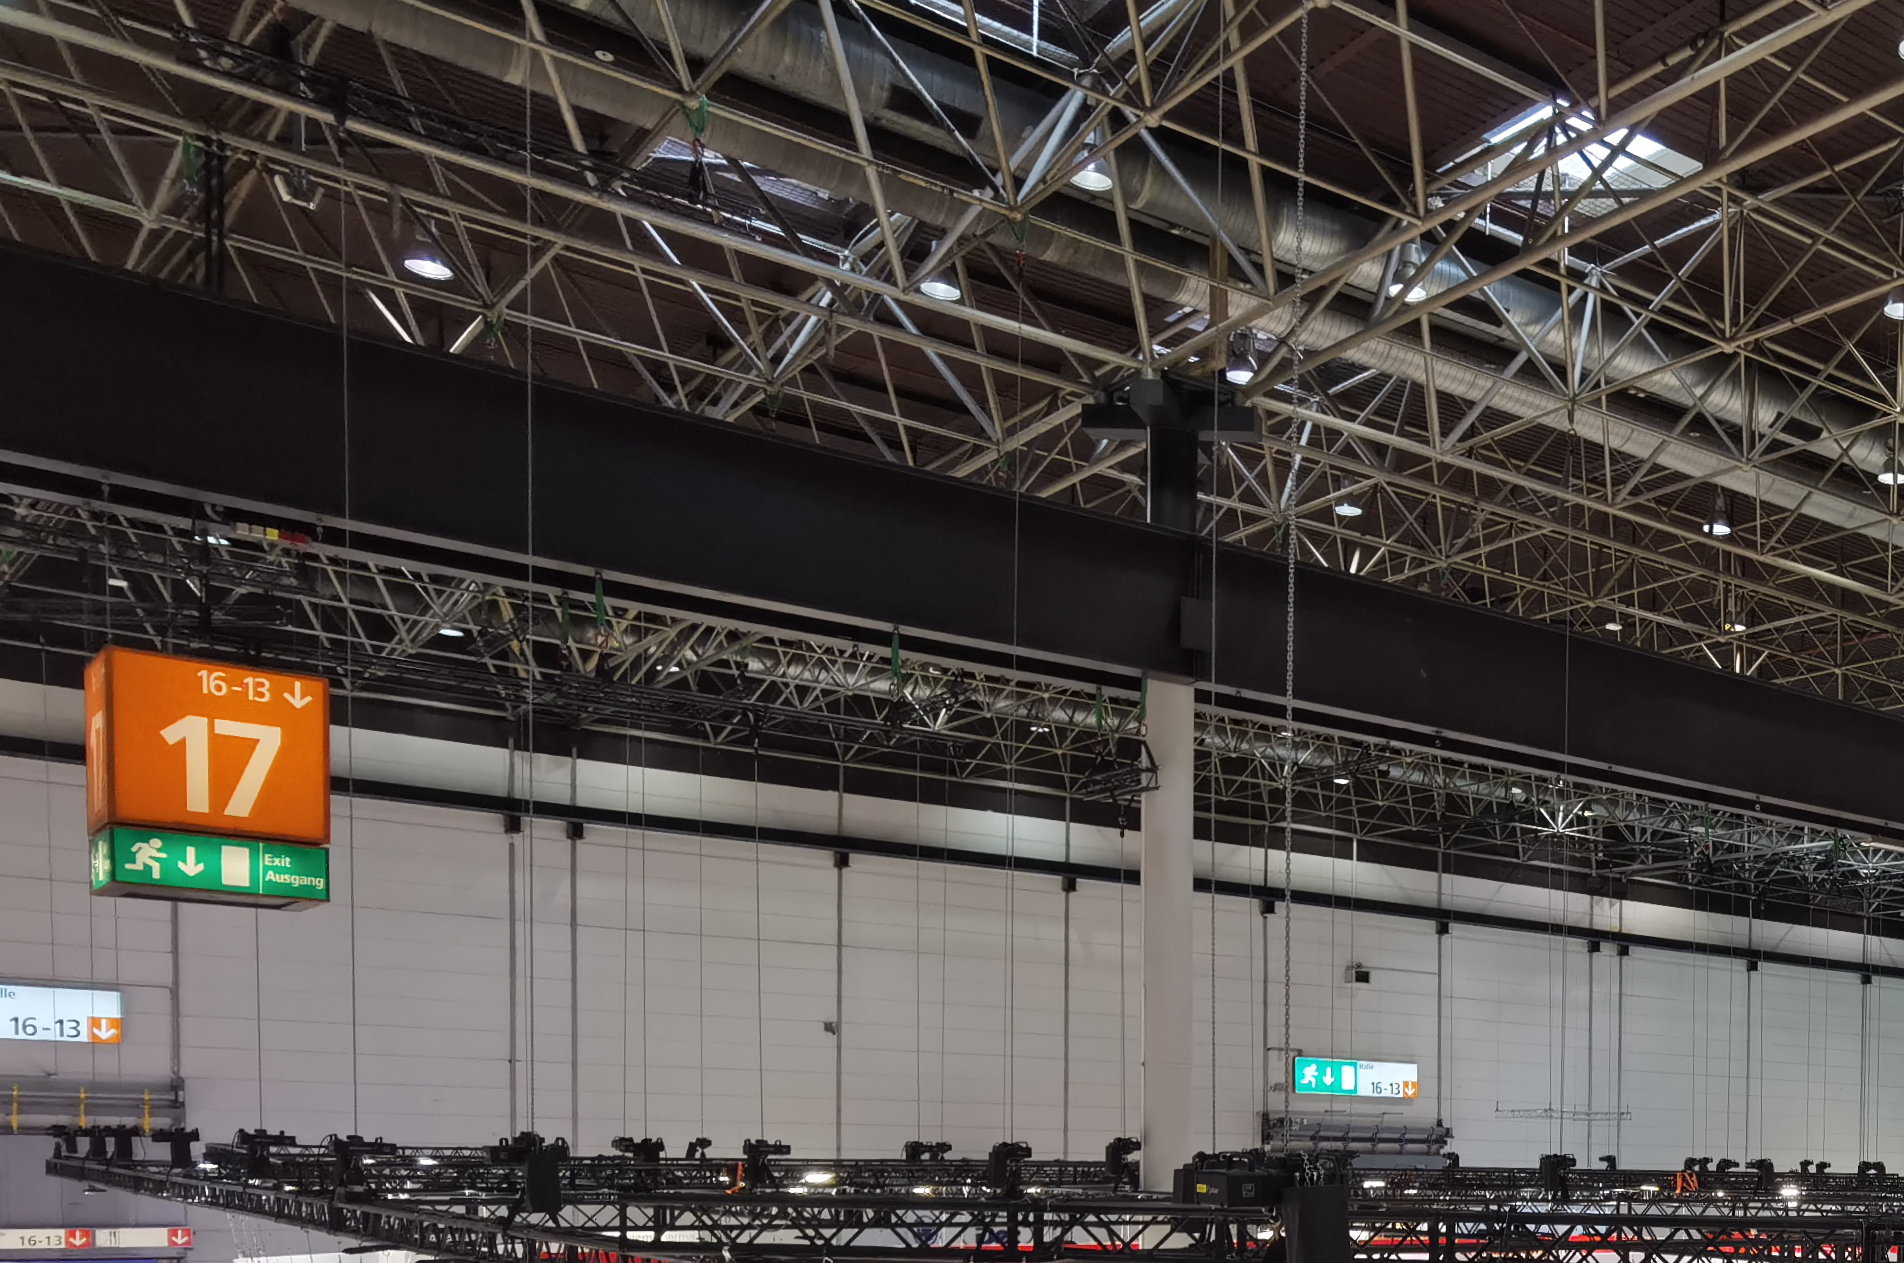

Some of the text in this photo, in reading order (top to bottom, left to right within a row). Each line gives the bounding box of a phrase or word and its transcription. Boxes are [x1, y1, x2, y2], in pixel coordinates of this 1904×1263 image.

[159, 714, 281, 817] 17
[264, 853, 291, 868] Exit
[265, 870, 325, 889] Ausgang
